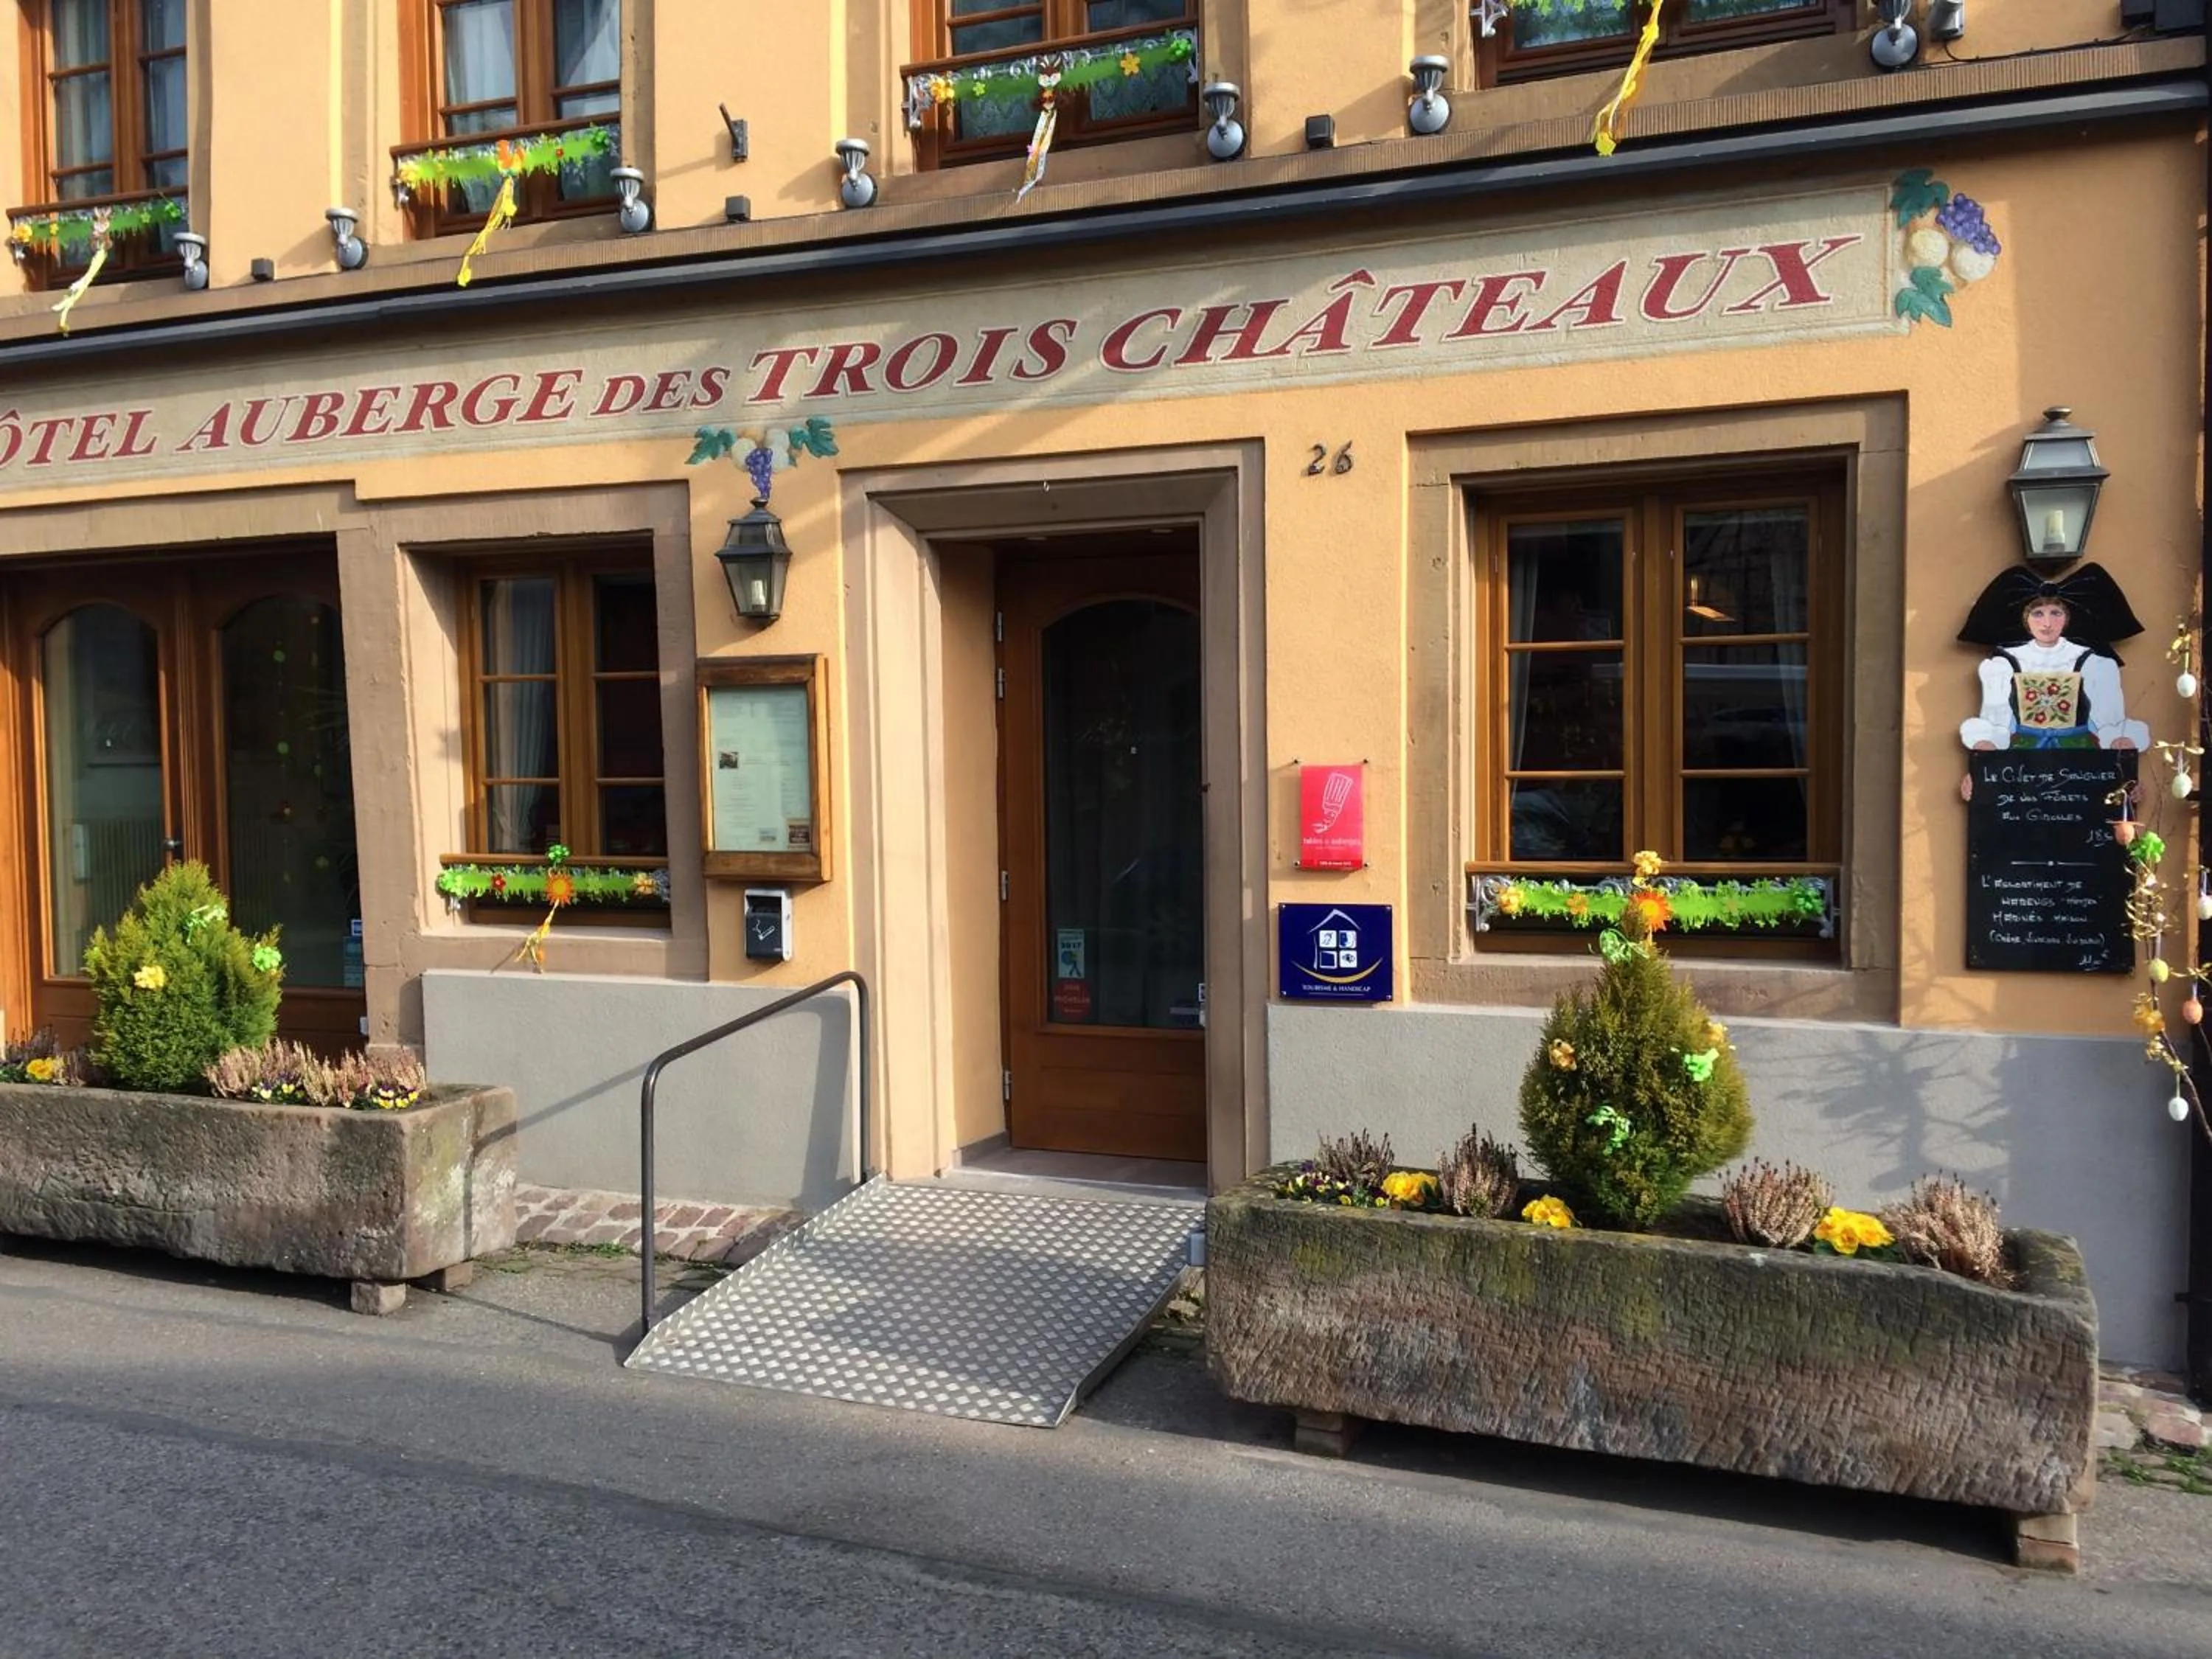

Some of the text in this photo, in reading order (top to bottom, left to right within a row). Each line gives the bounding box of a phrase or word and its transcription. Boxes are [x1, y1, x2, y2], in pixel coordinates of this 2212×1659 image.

[176, 368, 584, 452] AUBERGE
[592, 367, 731, 417] DES
[745, 319, 1078, 406] TROIS
[1099, 234, 1864, 374] CHÂTEAUX
[1307, 439, 1353, 476] 26
